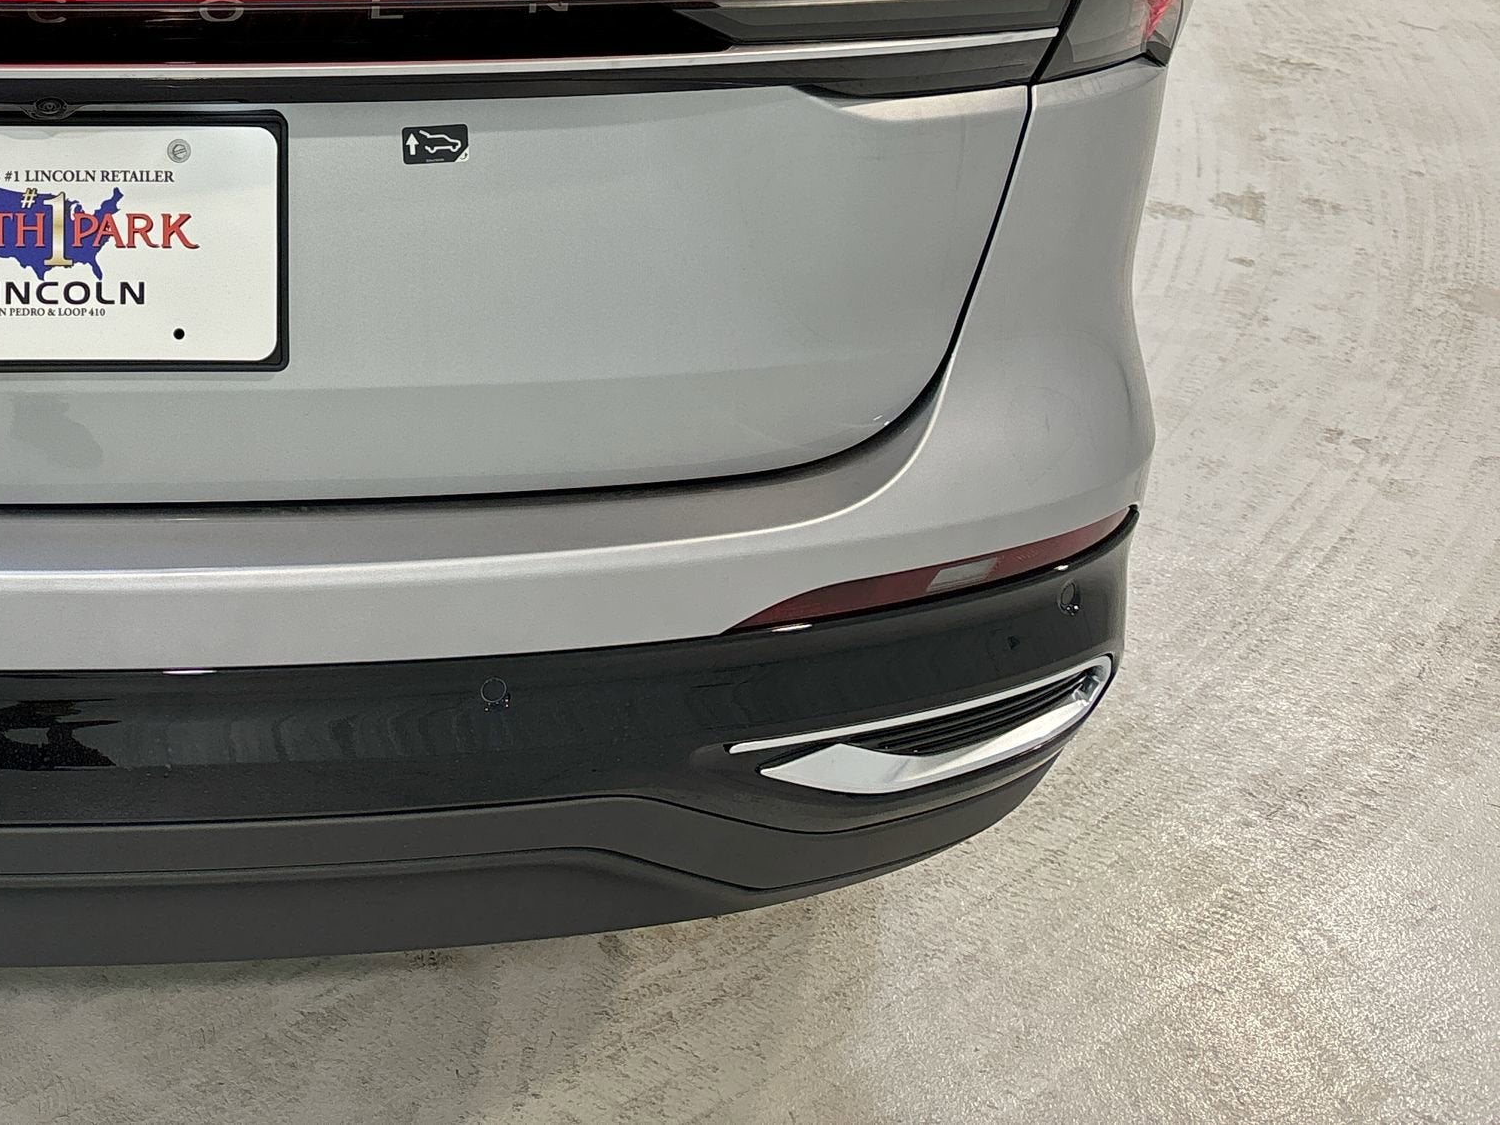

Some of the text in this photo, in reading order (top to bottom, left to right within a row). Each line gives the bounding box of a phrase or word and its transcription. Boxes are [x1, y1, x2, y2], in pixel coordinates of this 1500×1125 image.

[4, 171, 20, 182] #1
[25, 170, 96, 182] LINCOLN
[100, 170, 174, 182] RETAILER
[71, 213, 200, 249] PARK
[9, 307, 45, 316] PEDRO
[47, 307, 56, 316] &
[58, 307, 87, 316] LOOP
[88, 307, 106, 316] 410
